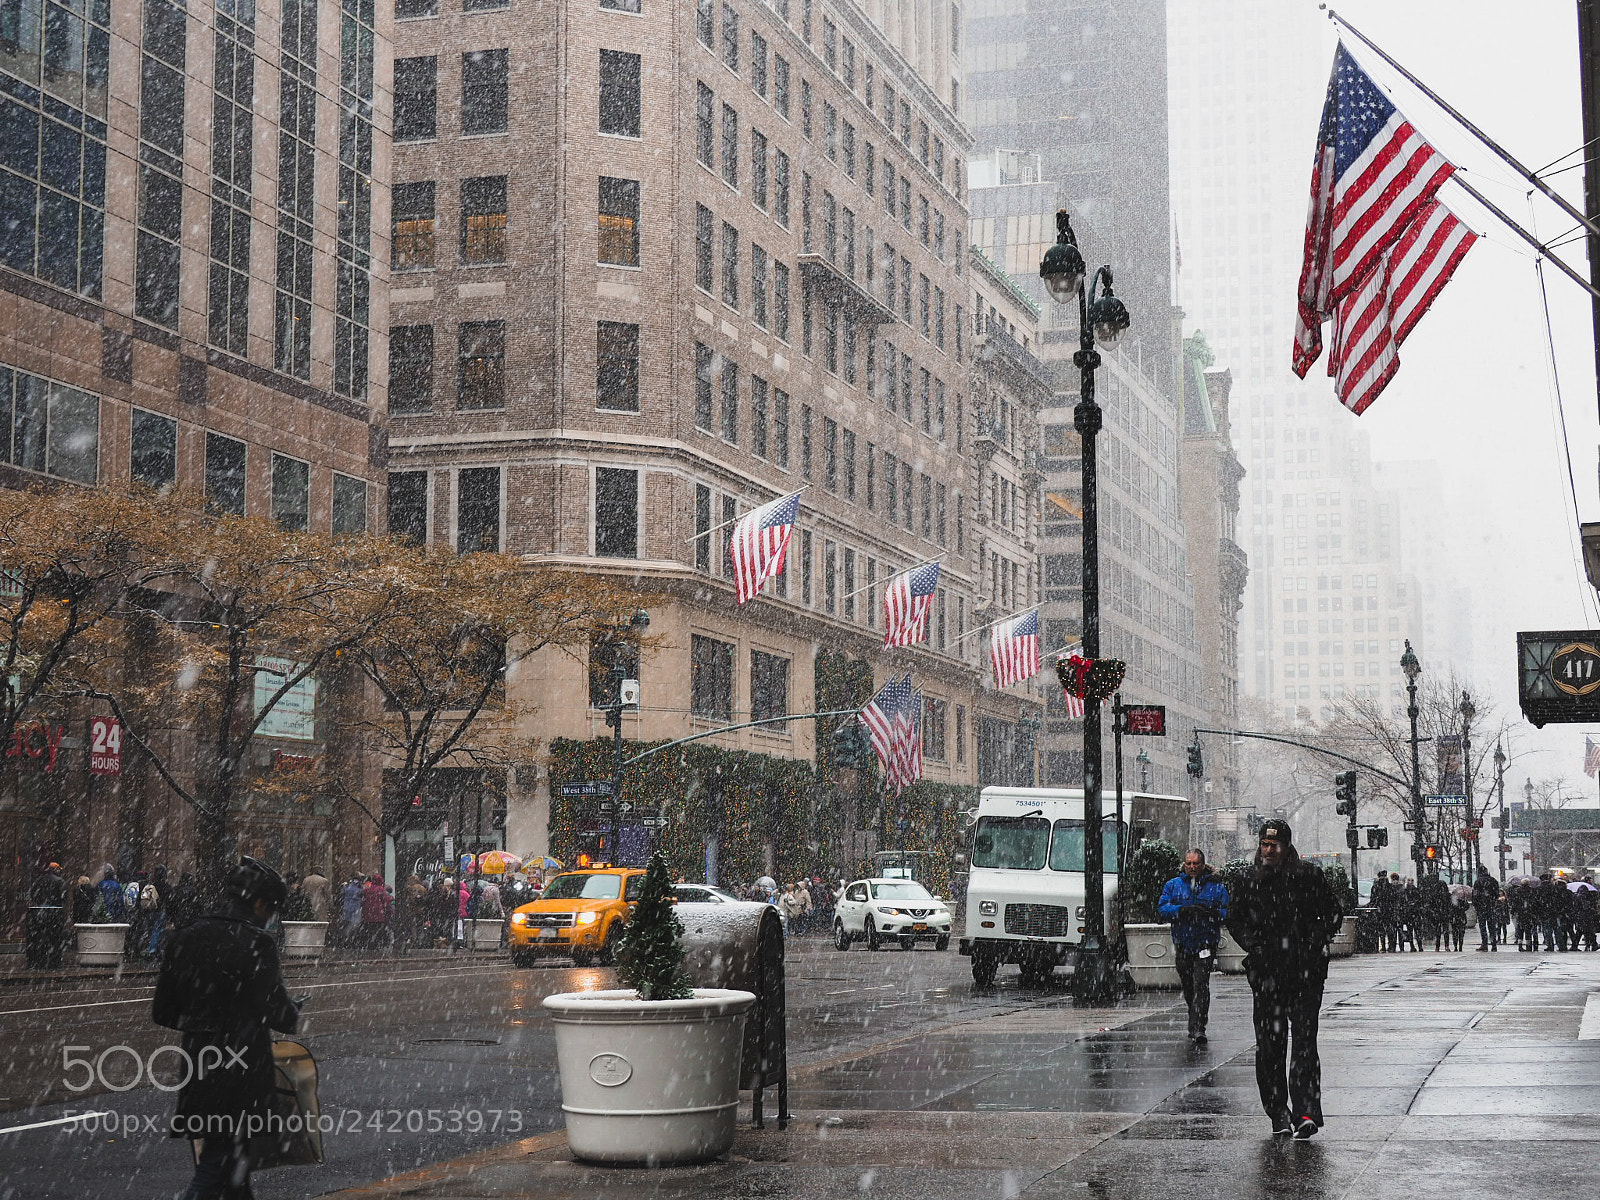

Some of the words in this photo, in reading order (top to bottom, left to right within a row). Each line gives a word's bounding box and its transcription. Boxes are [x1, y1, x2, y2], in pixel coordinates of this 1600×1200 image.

[1562, 660, 1594, 678] 417
[92, 721, 120, 754] 24
[91, 757, 120, 771] HOURS
